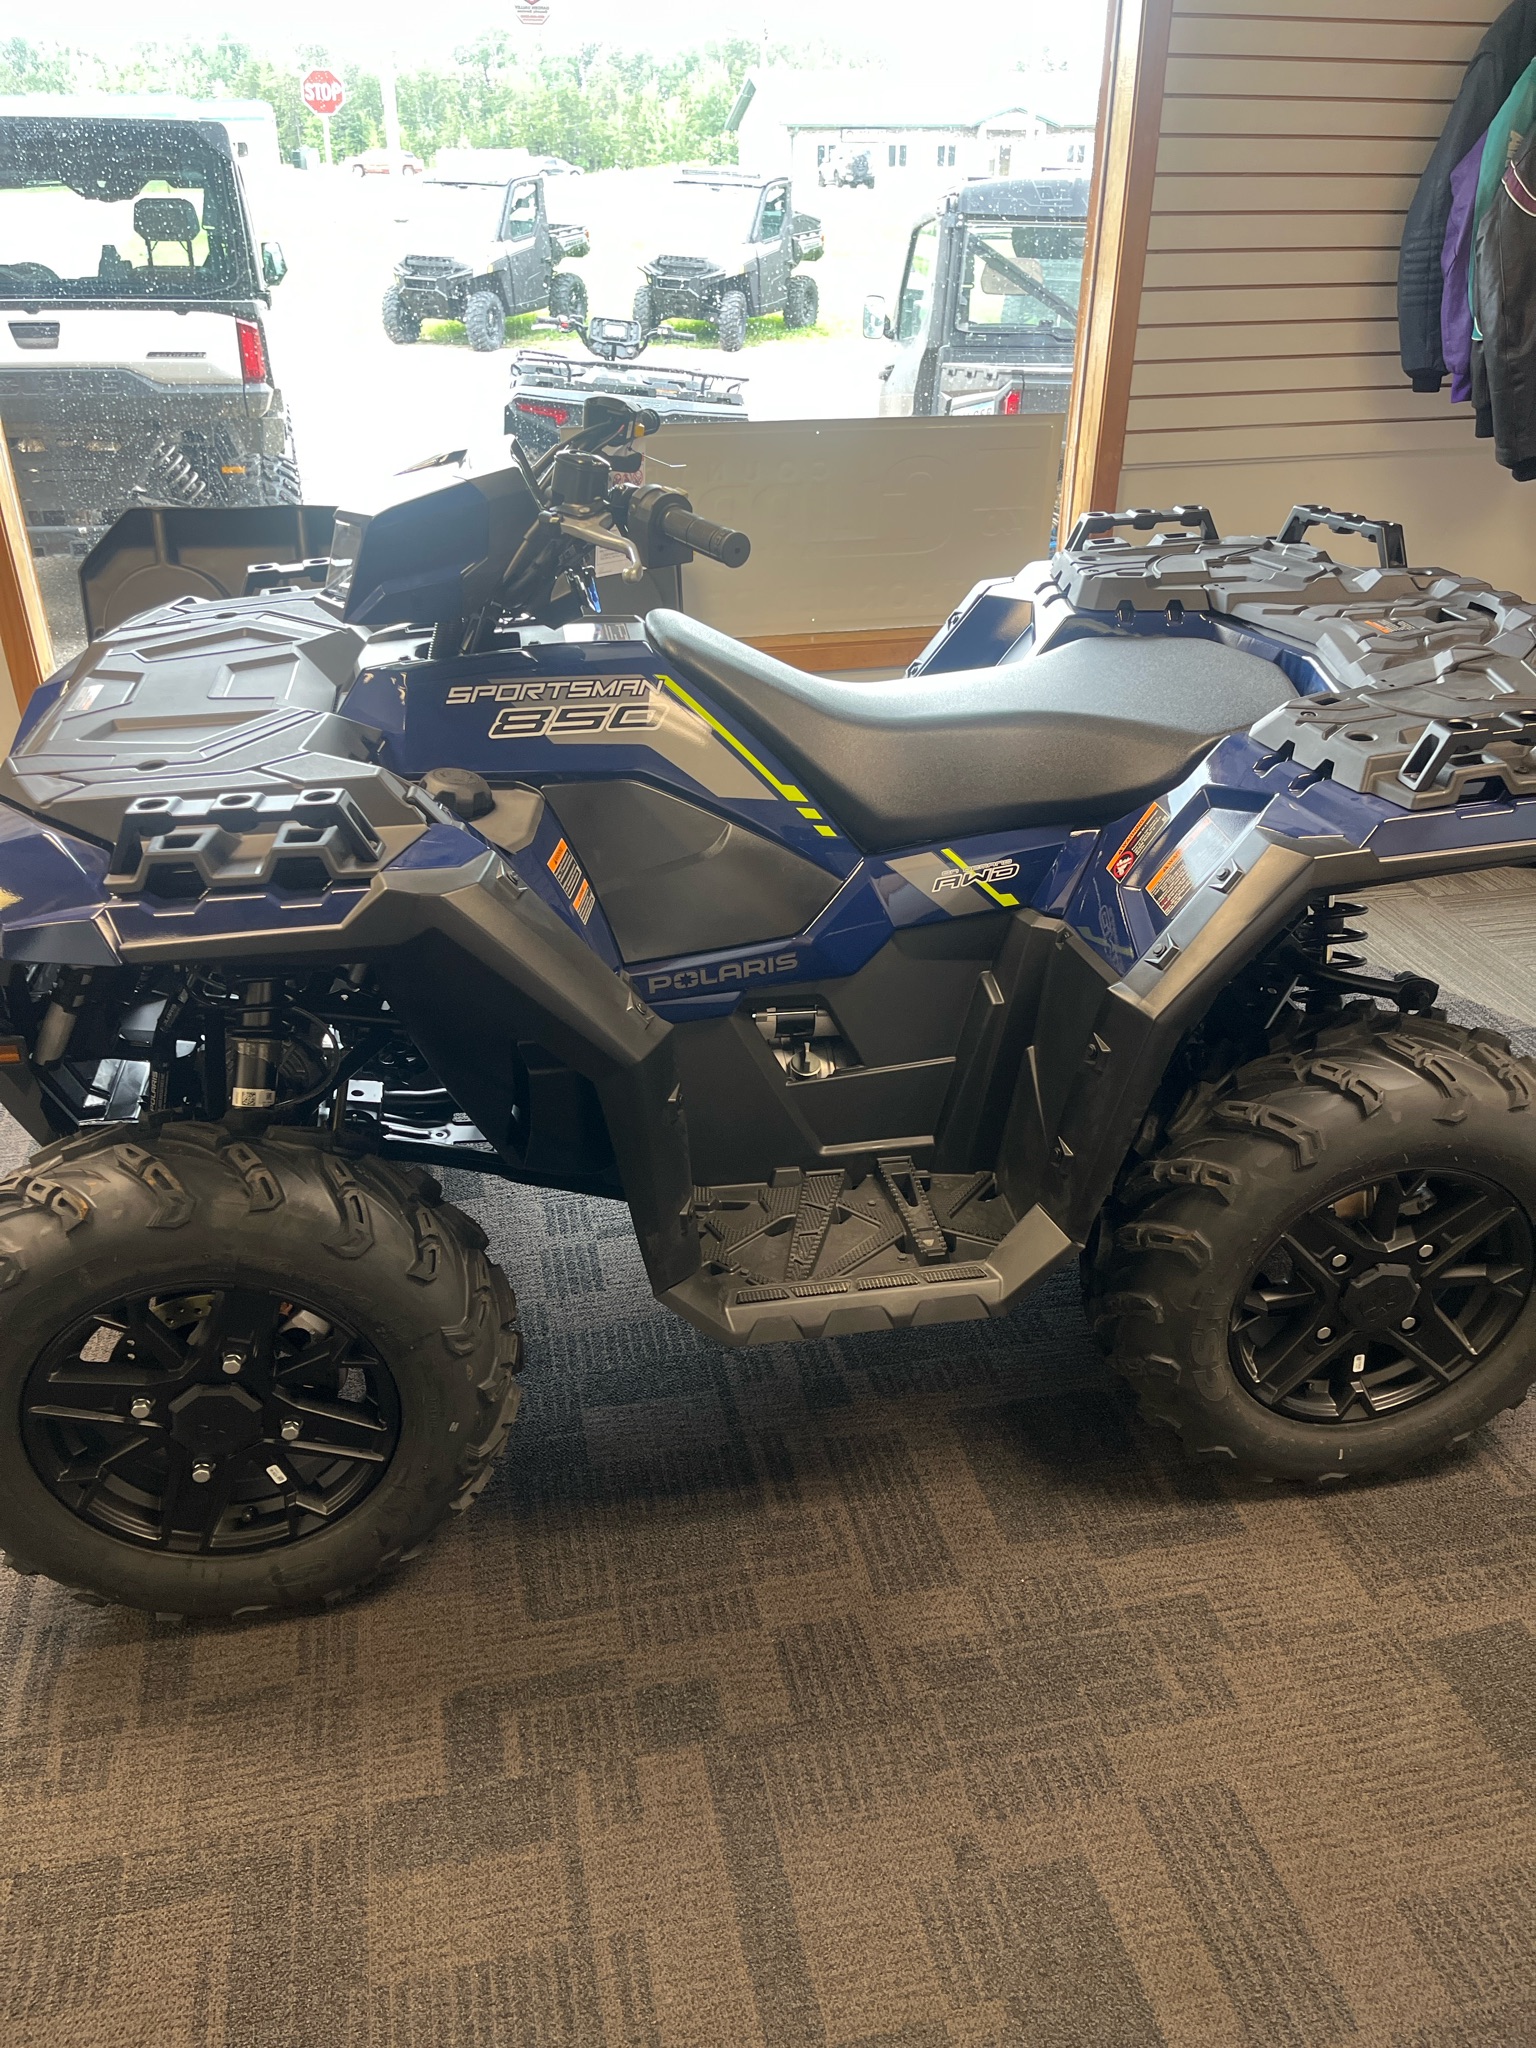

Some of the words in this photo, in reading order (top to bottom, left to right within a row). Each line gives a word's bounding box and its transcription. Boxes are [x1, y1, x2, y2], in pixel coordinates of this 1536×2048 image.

[304, 81, 342, 102] STOP
[445, 678, 664, 705] SPORTSMAN
[488, 702, 670, 739] 850
[931, 863, 1020, 893] AWD
[647, 951, 799, 995] POLARIS
[149, 1070, 159, 1112] POLARIS
